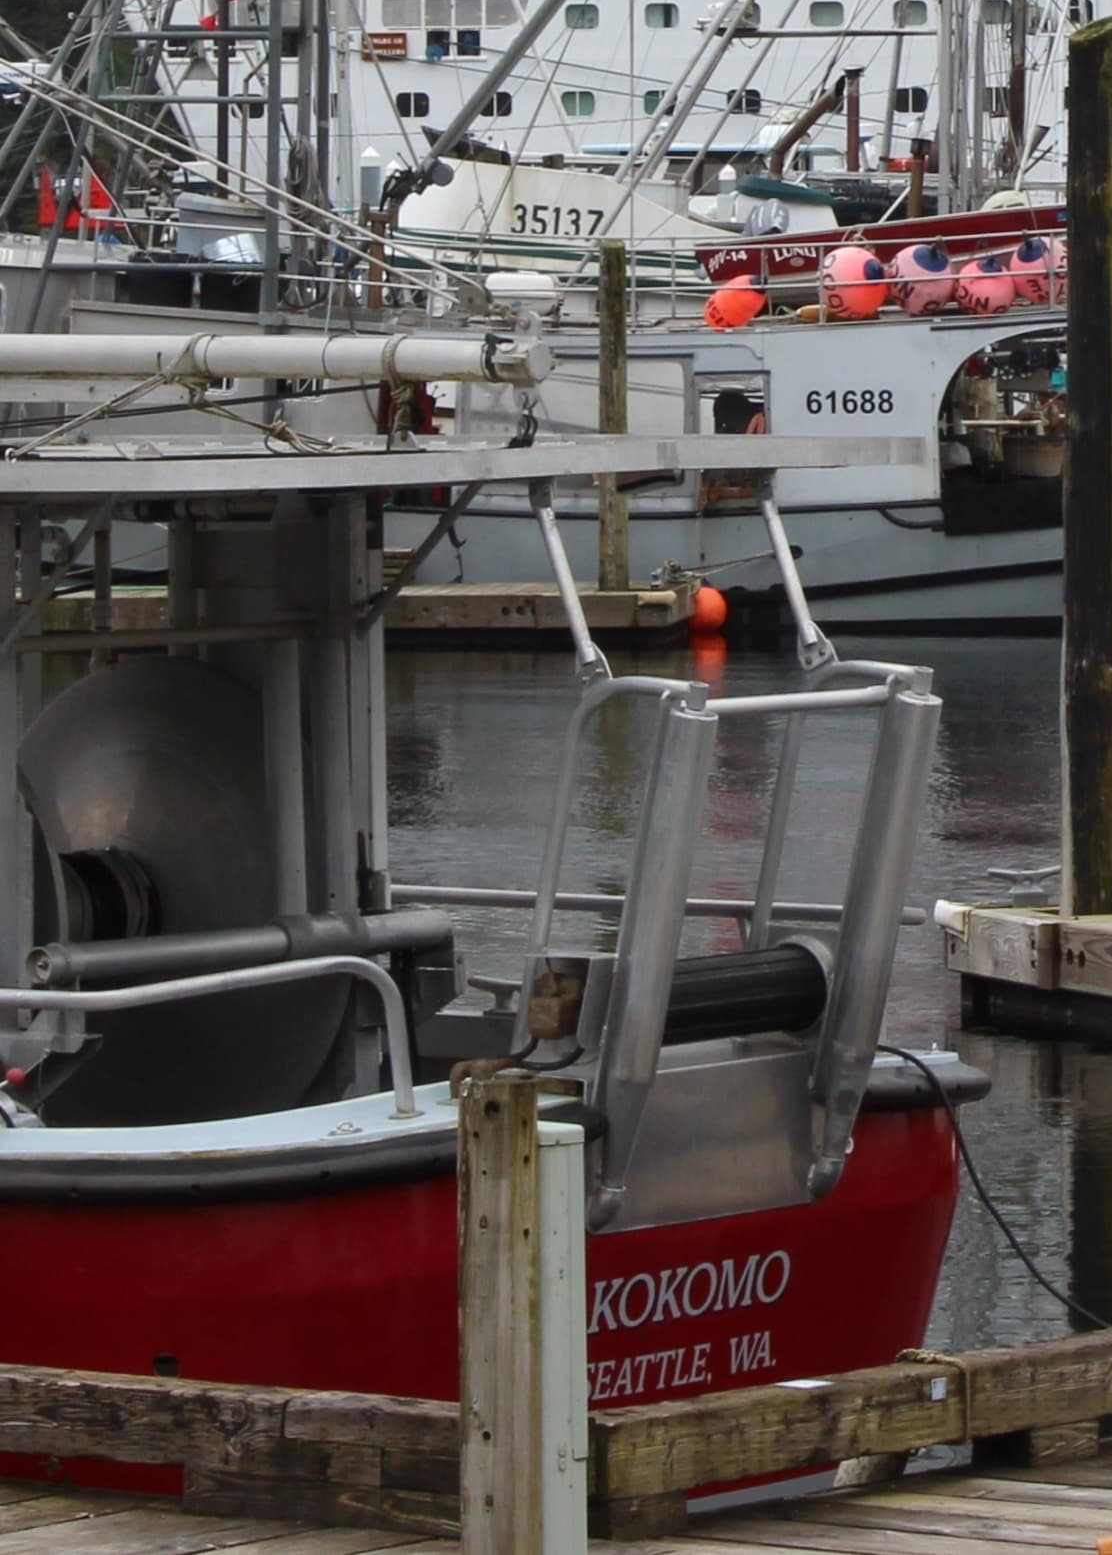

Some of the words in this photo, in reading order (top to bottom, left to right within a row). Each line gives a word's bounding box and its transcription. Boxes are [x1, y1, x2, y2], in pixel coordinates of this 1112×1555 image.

[510, 203, 605, 242] 35137
[805, 389, 894, 415] 61688
[586, 1249, 791, 1335] KOKOMO
[728, 1330, 777, 1375] WA.
